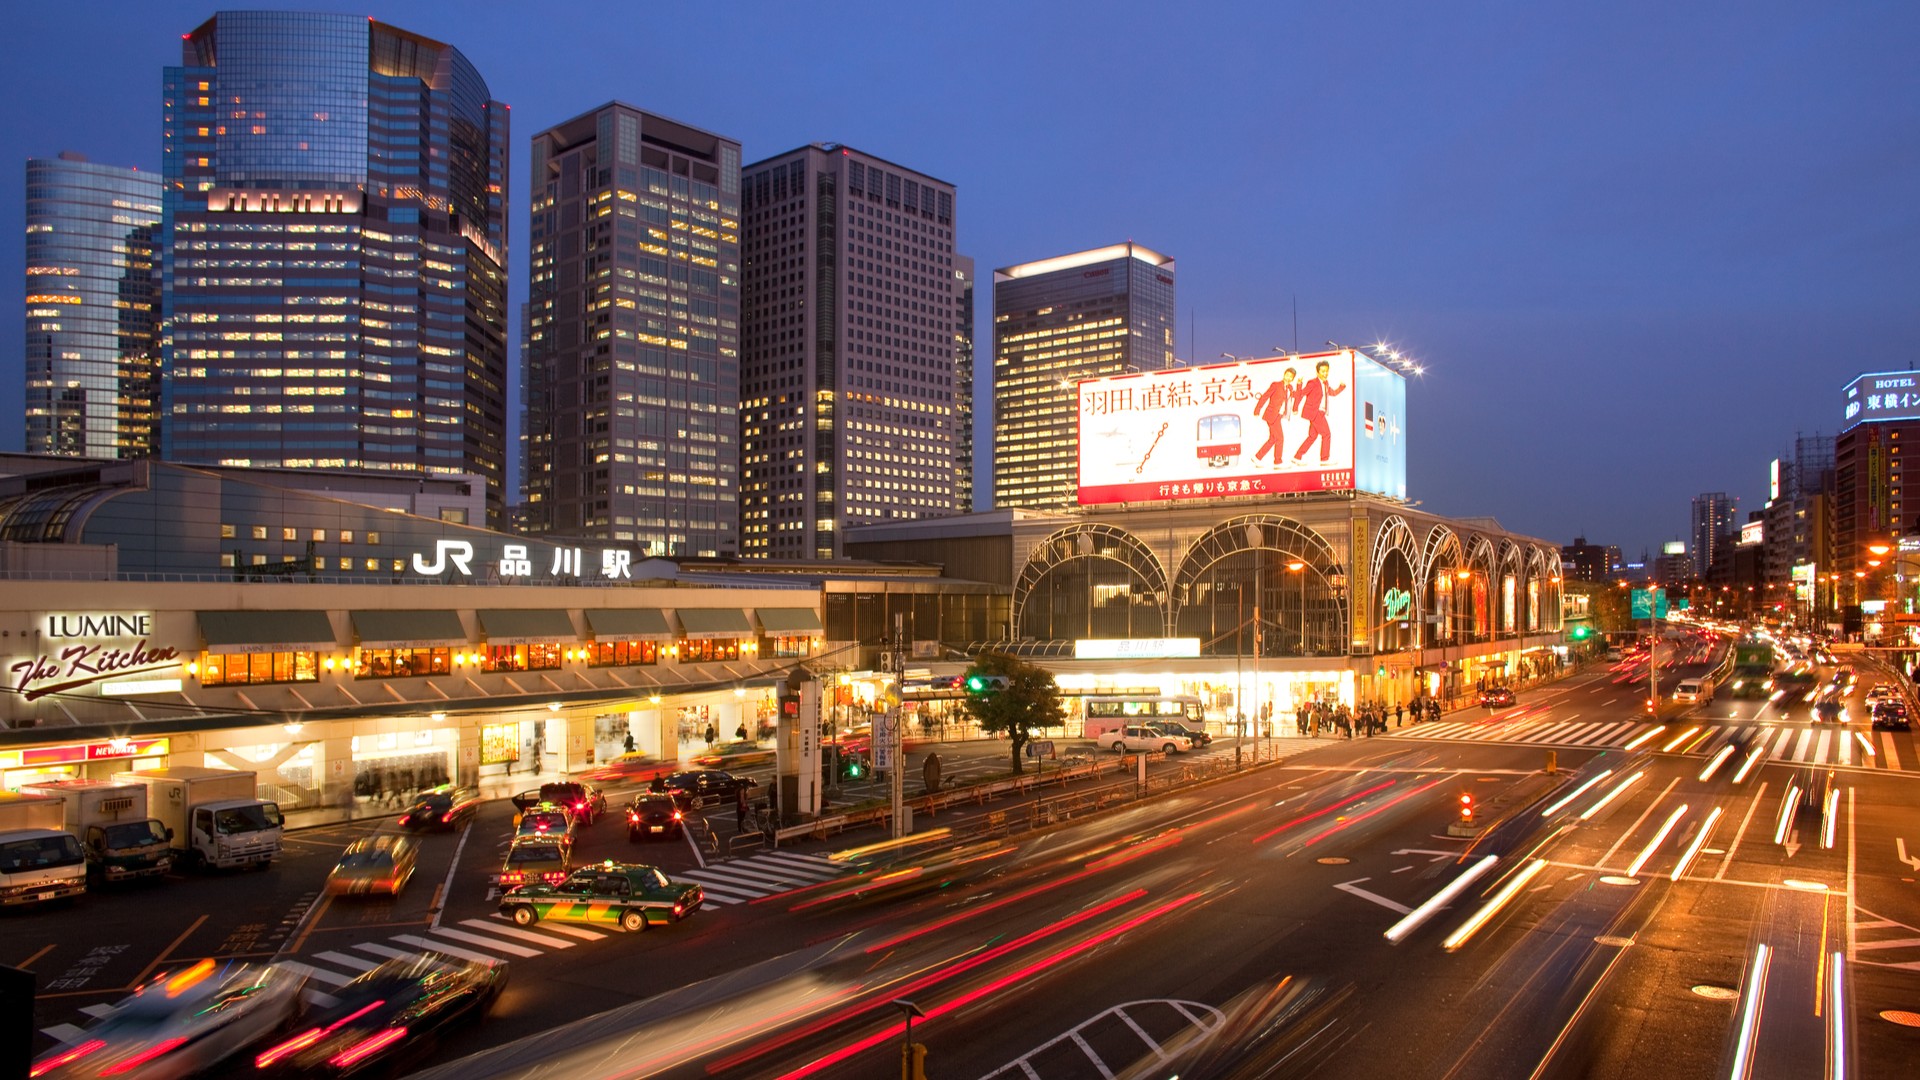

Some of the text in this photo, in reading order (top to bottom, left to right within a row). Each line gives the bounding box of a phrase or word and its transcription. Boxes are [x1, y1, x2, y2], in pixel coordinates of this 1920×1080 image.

[1875, 378, 1916, 389] HOTEL
[1084, 373, 1263, 416] 羽田、直結、京急。
[1320, 472, 1351, 482] KEIKYU
[1159, 479, 1267, 497] 行きも帰りも京急で。
[412, 539, 632, 579] JR 品川駅
[1382, 586, 1411, 622] Wing
[48, 614, 151, 638] LUMINE
[240, 644, 264, 653] LUMINE
[1117, 640, 1165, 652] 品川駅
[10, 639, 181, 694] The Kitchen
[95, 744, 138, 756] NEWDAYS
[169, 787, 181, 799] JR
